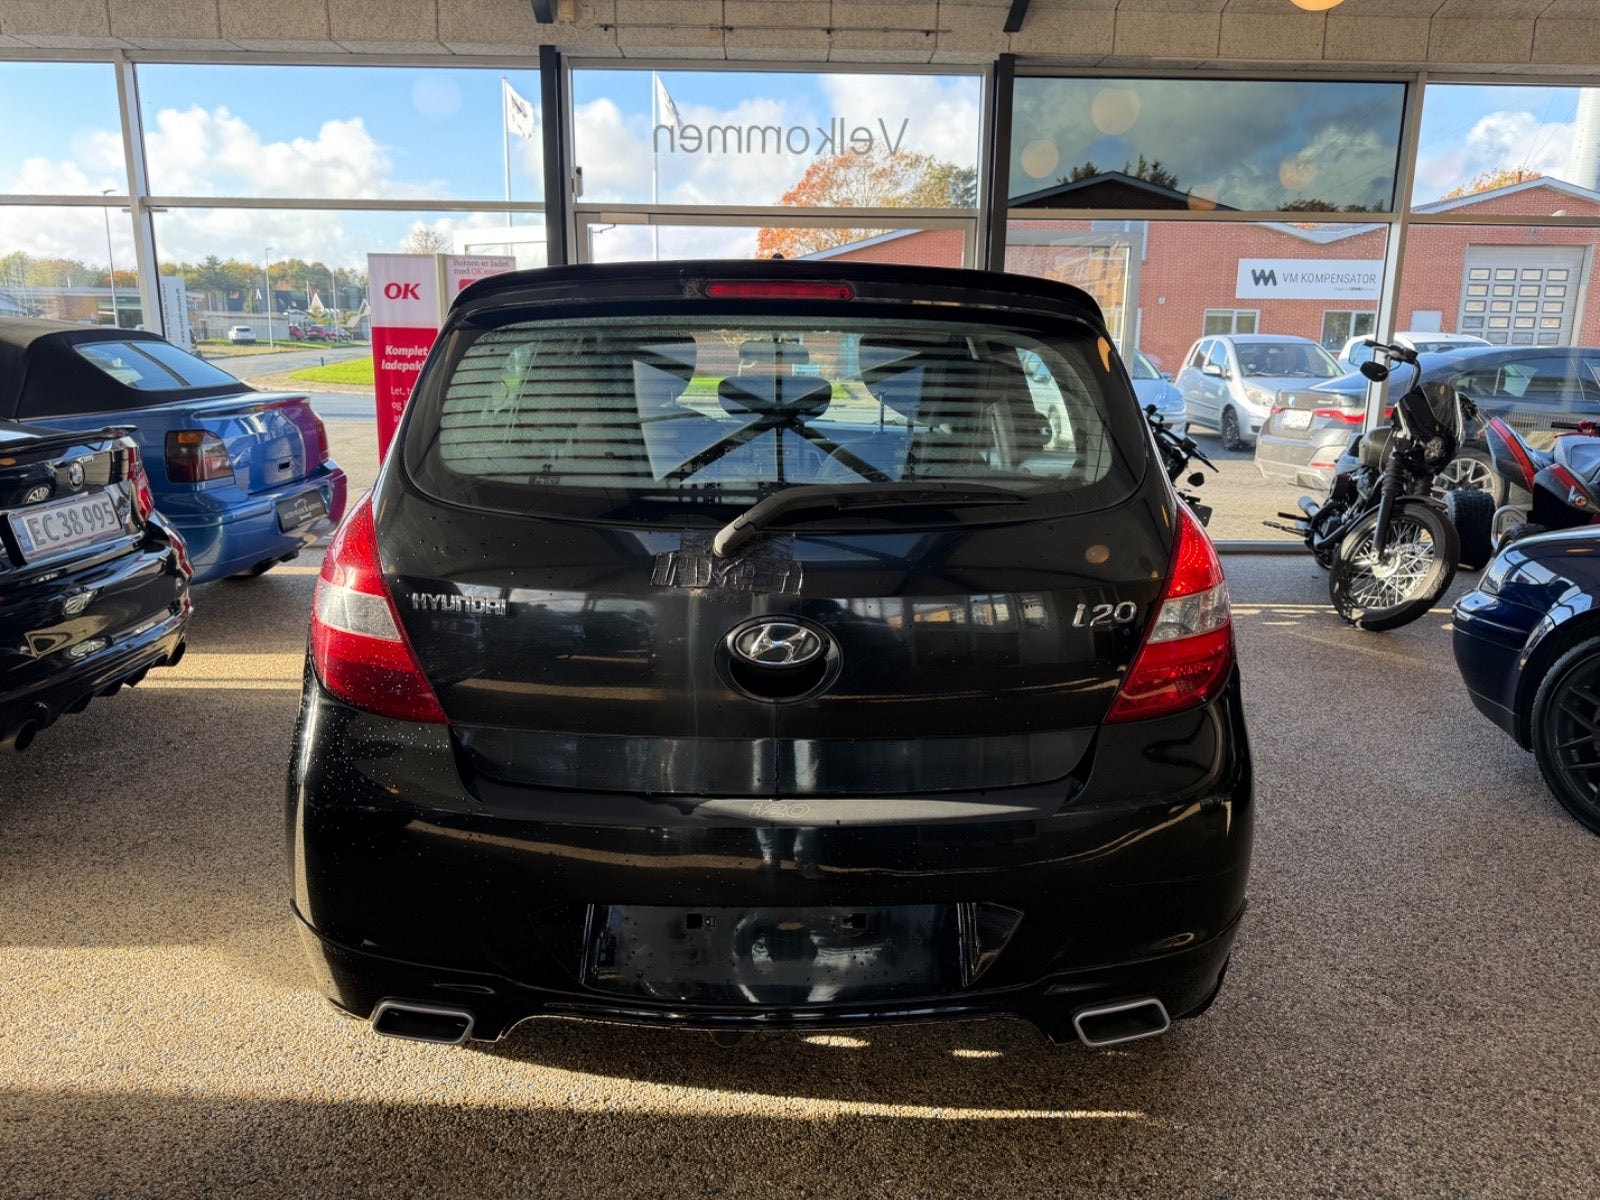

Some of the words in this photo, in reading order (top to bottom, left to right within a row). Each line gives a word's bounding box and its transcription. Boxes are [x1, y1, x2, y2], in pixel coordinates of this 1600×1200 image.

[1282, 272, 1298, 284] VM
[1301, 272, 1377, 285] KOMPENSATOR
[384, 282, 421, 301] OK
[385, 345, 429, 359] Komplet
[381, 359, 426, 373] ladepak
[27, 513, 60, 546] EC
[56, 508, 84, 538] 38
[81, 502, 115, 532] 995
[412, 592, 506, 616] HYUNDAI
